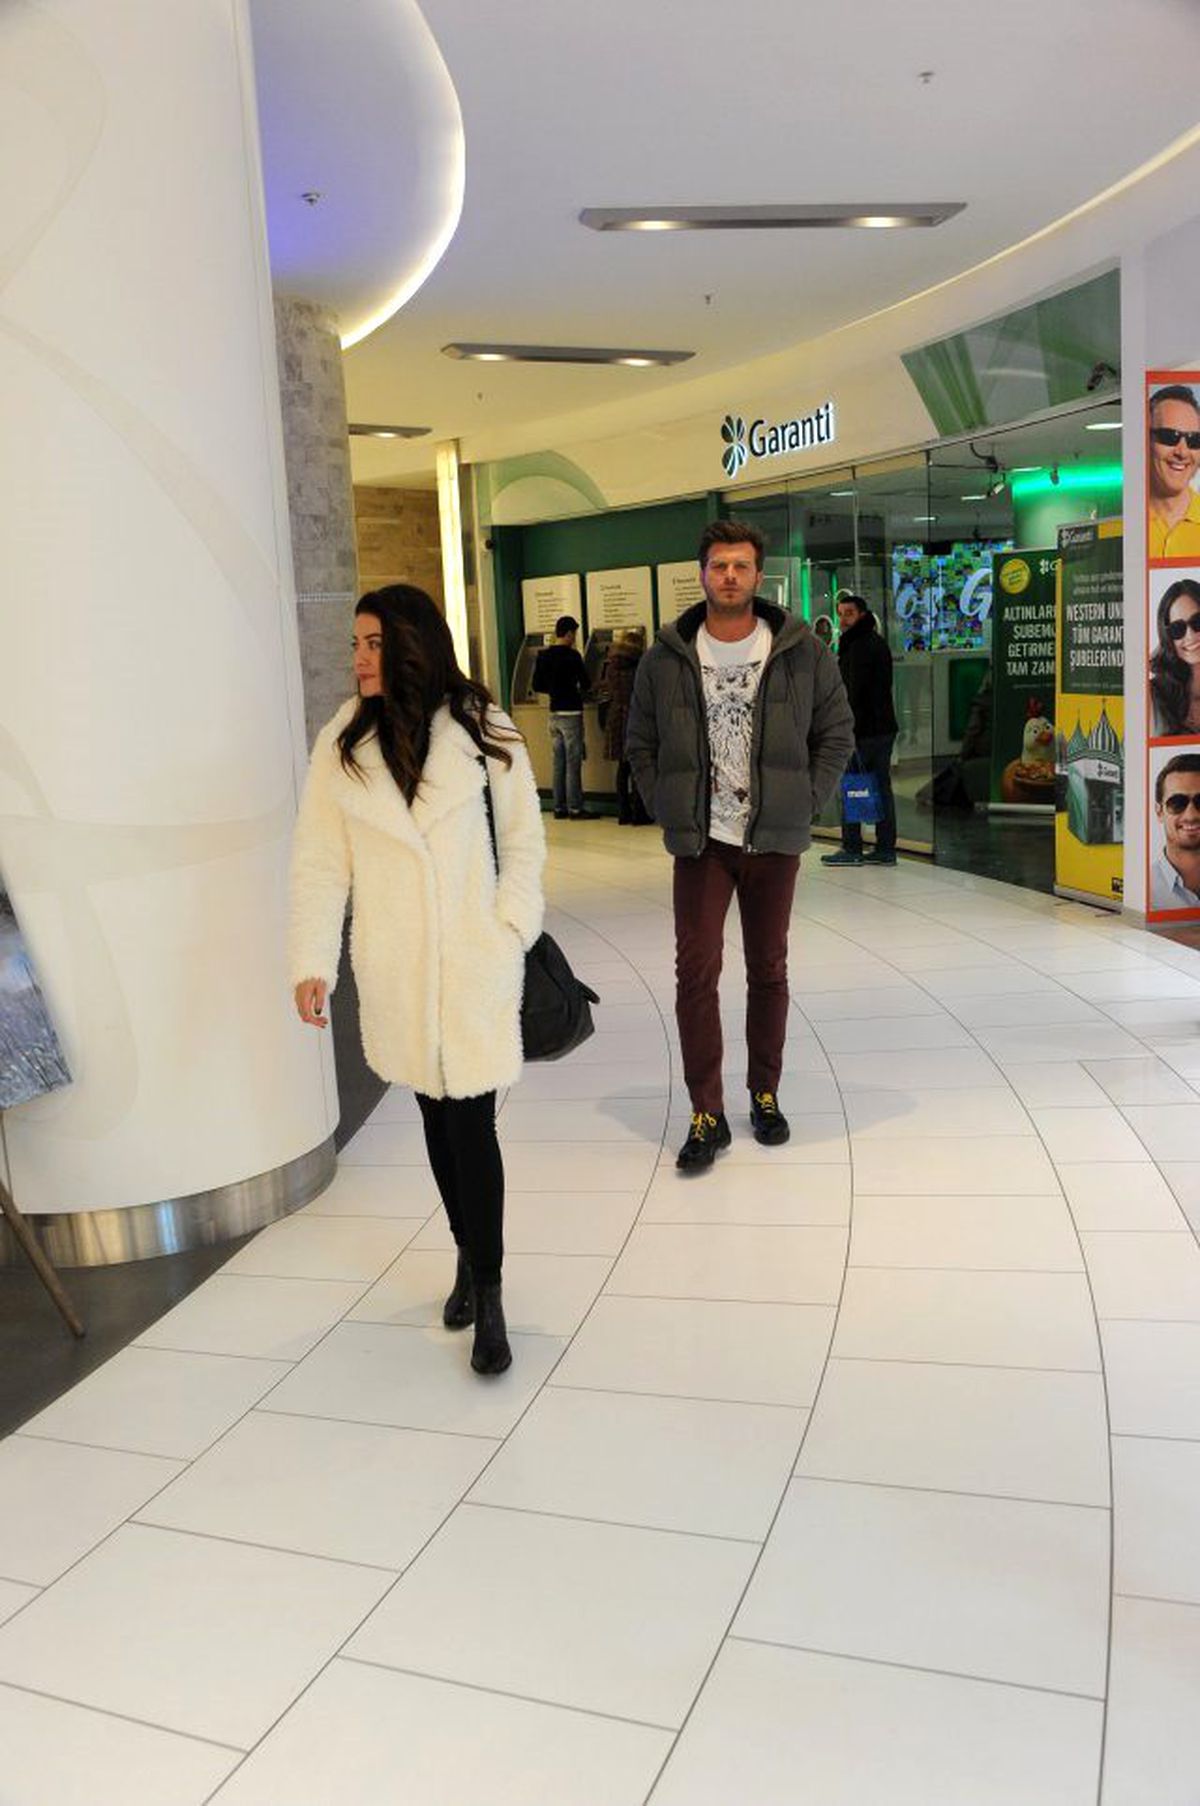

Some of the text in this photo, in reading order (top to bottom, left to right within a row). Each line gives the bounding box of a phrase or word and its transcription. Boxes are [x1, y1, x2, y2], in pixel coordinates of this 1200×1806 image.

[748, 402, 832, 457] Garanti
[1066, 603, 1105, 621] WESTERN
[1006, 661, 1028, 676] TAM
